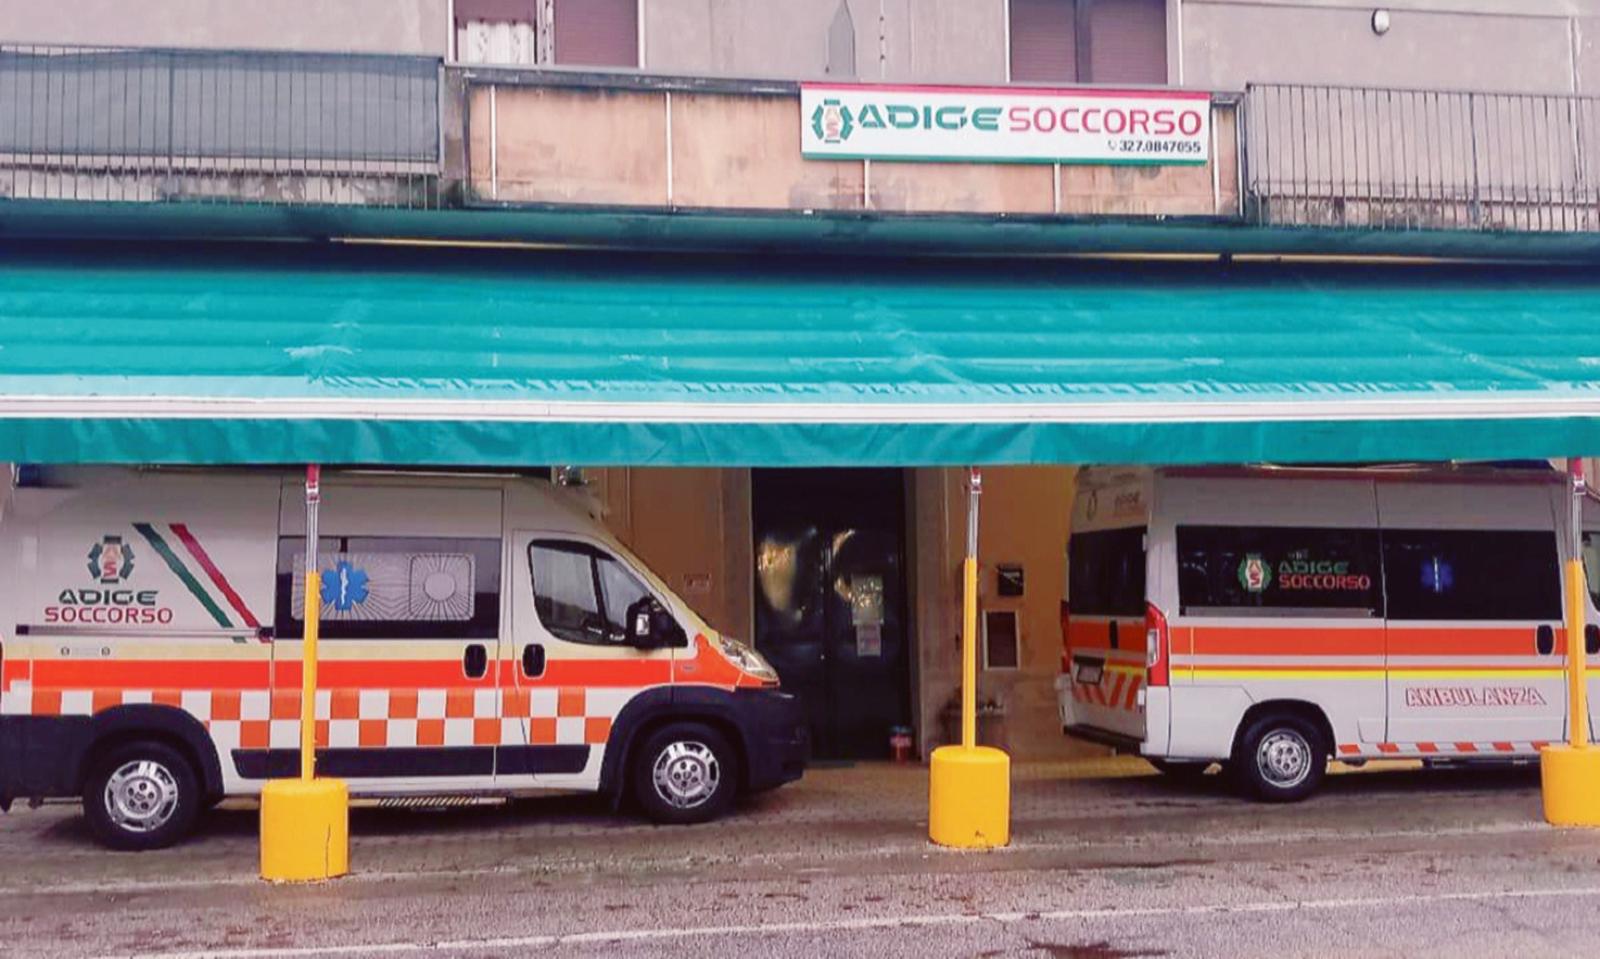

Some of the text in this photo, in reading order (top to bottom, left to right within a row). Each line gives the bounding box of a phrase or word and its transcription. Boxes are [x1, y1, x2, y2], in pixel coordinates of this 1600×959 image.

[858, 104, 1202, 136] ADIGE SOCCORSO
[1119, 140, 1202, 154] 327.0847055
[1278, 559, 1350, 574] ADIGE
[1278, 574, 1371, 591] SOCCORSO
[58, 589, 159, 606] ADIGE
[44, 606, 174, 624] SOCCORSO
[1405, 687, 1548, 707] AMBULANZA
